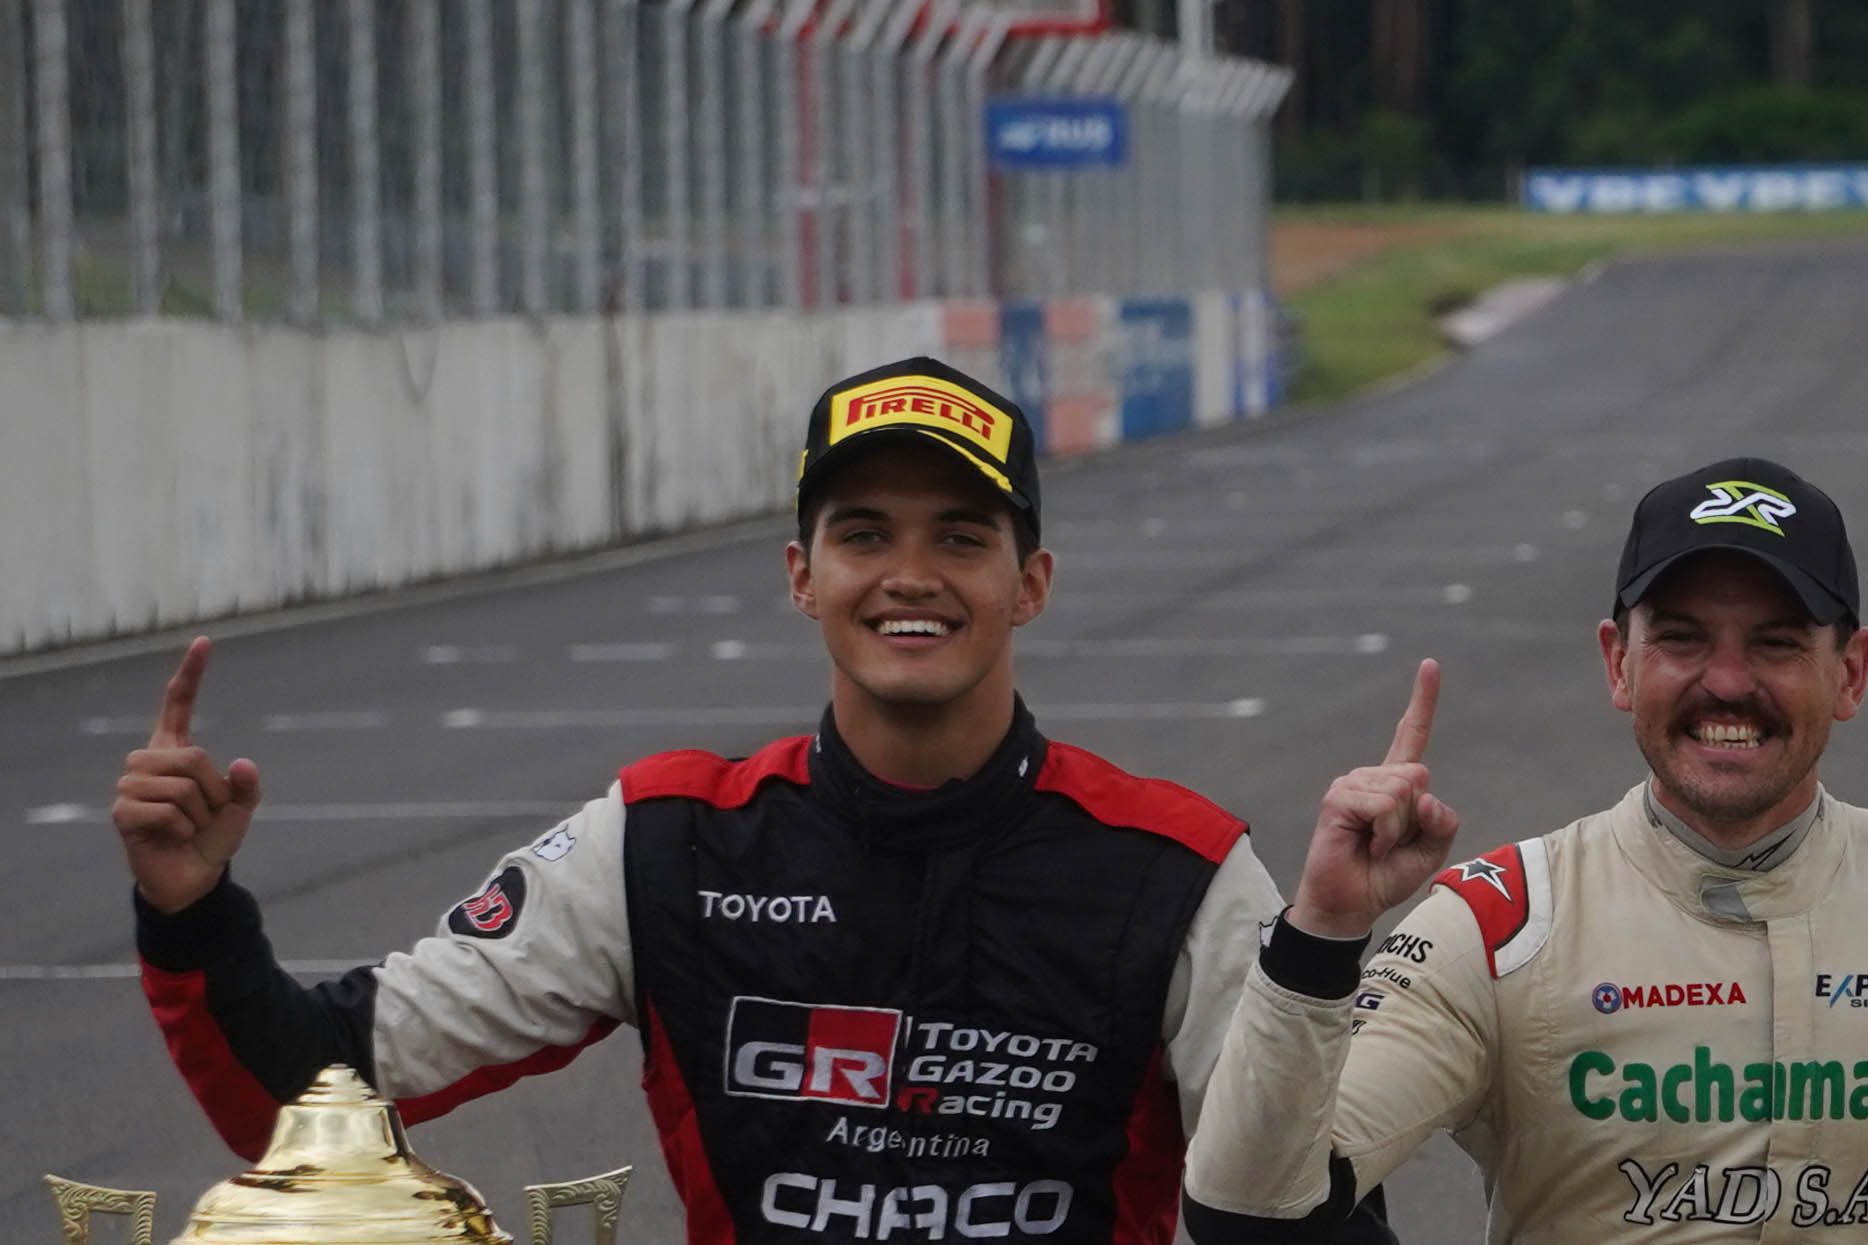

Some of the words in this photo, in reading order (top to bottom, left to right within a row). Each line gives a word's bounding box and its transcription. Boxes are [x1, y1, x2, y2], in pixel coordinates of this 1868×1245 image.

[846, 385, 996, 441] PIRELLI
[698, 890, 836, 922] TOYOTA
[1622, 982, 1747, 1009] MADEXA
[917, 1023, 1099, 1063] TOYOTA
[733, 1041, 888, 1099] GR
[908, 1055, 1077, 1093] GAZOO
[897, 1087, 1064, 1131] Racing
[826, 1117, 991, 1158] Argentina
[760, 1172, 1075, 1241] CHACO
[1618, 1158, 1782, 1226] YAD
